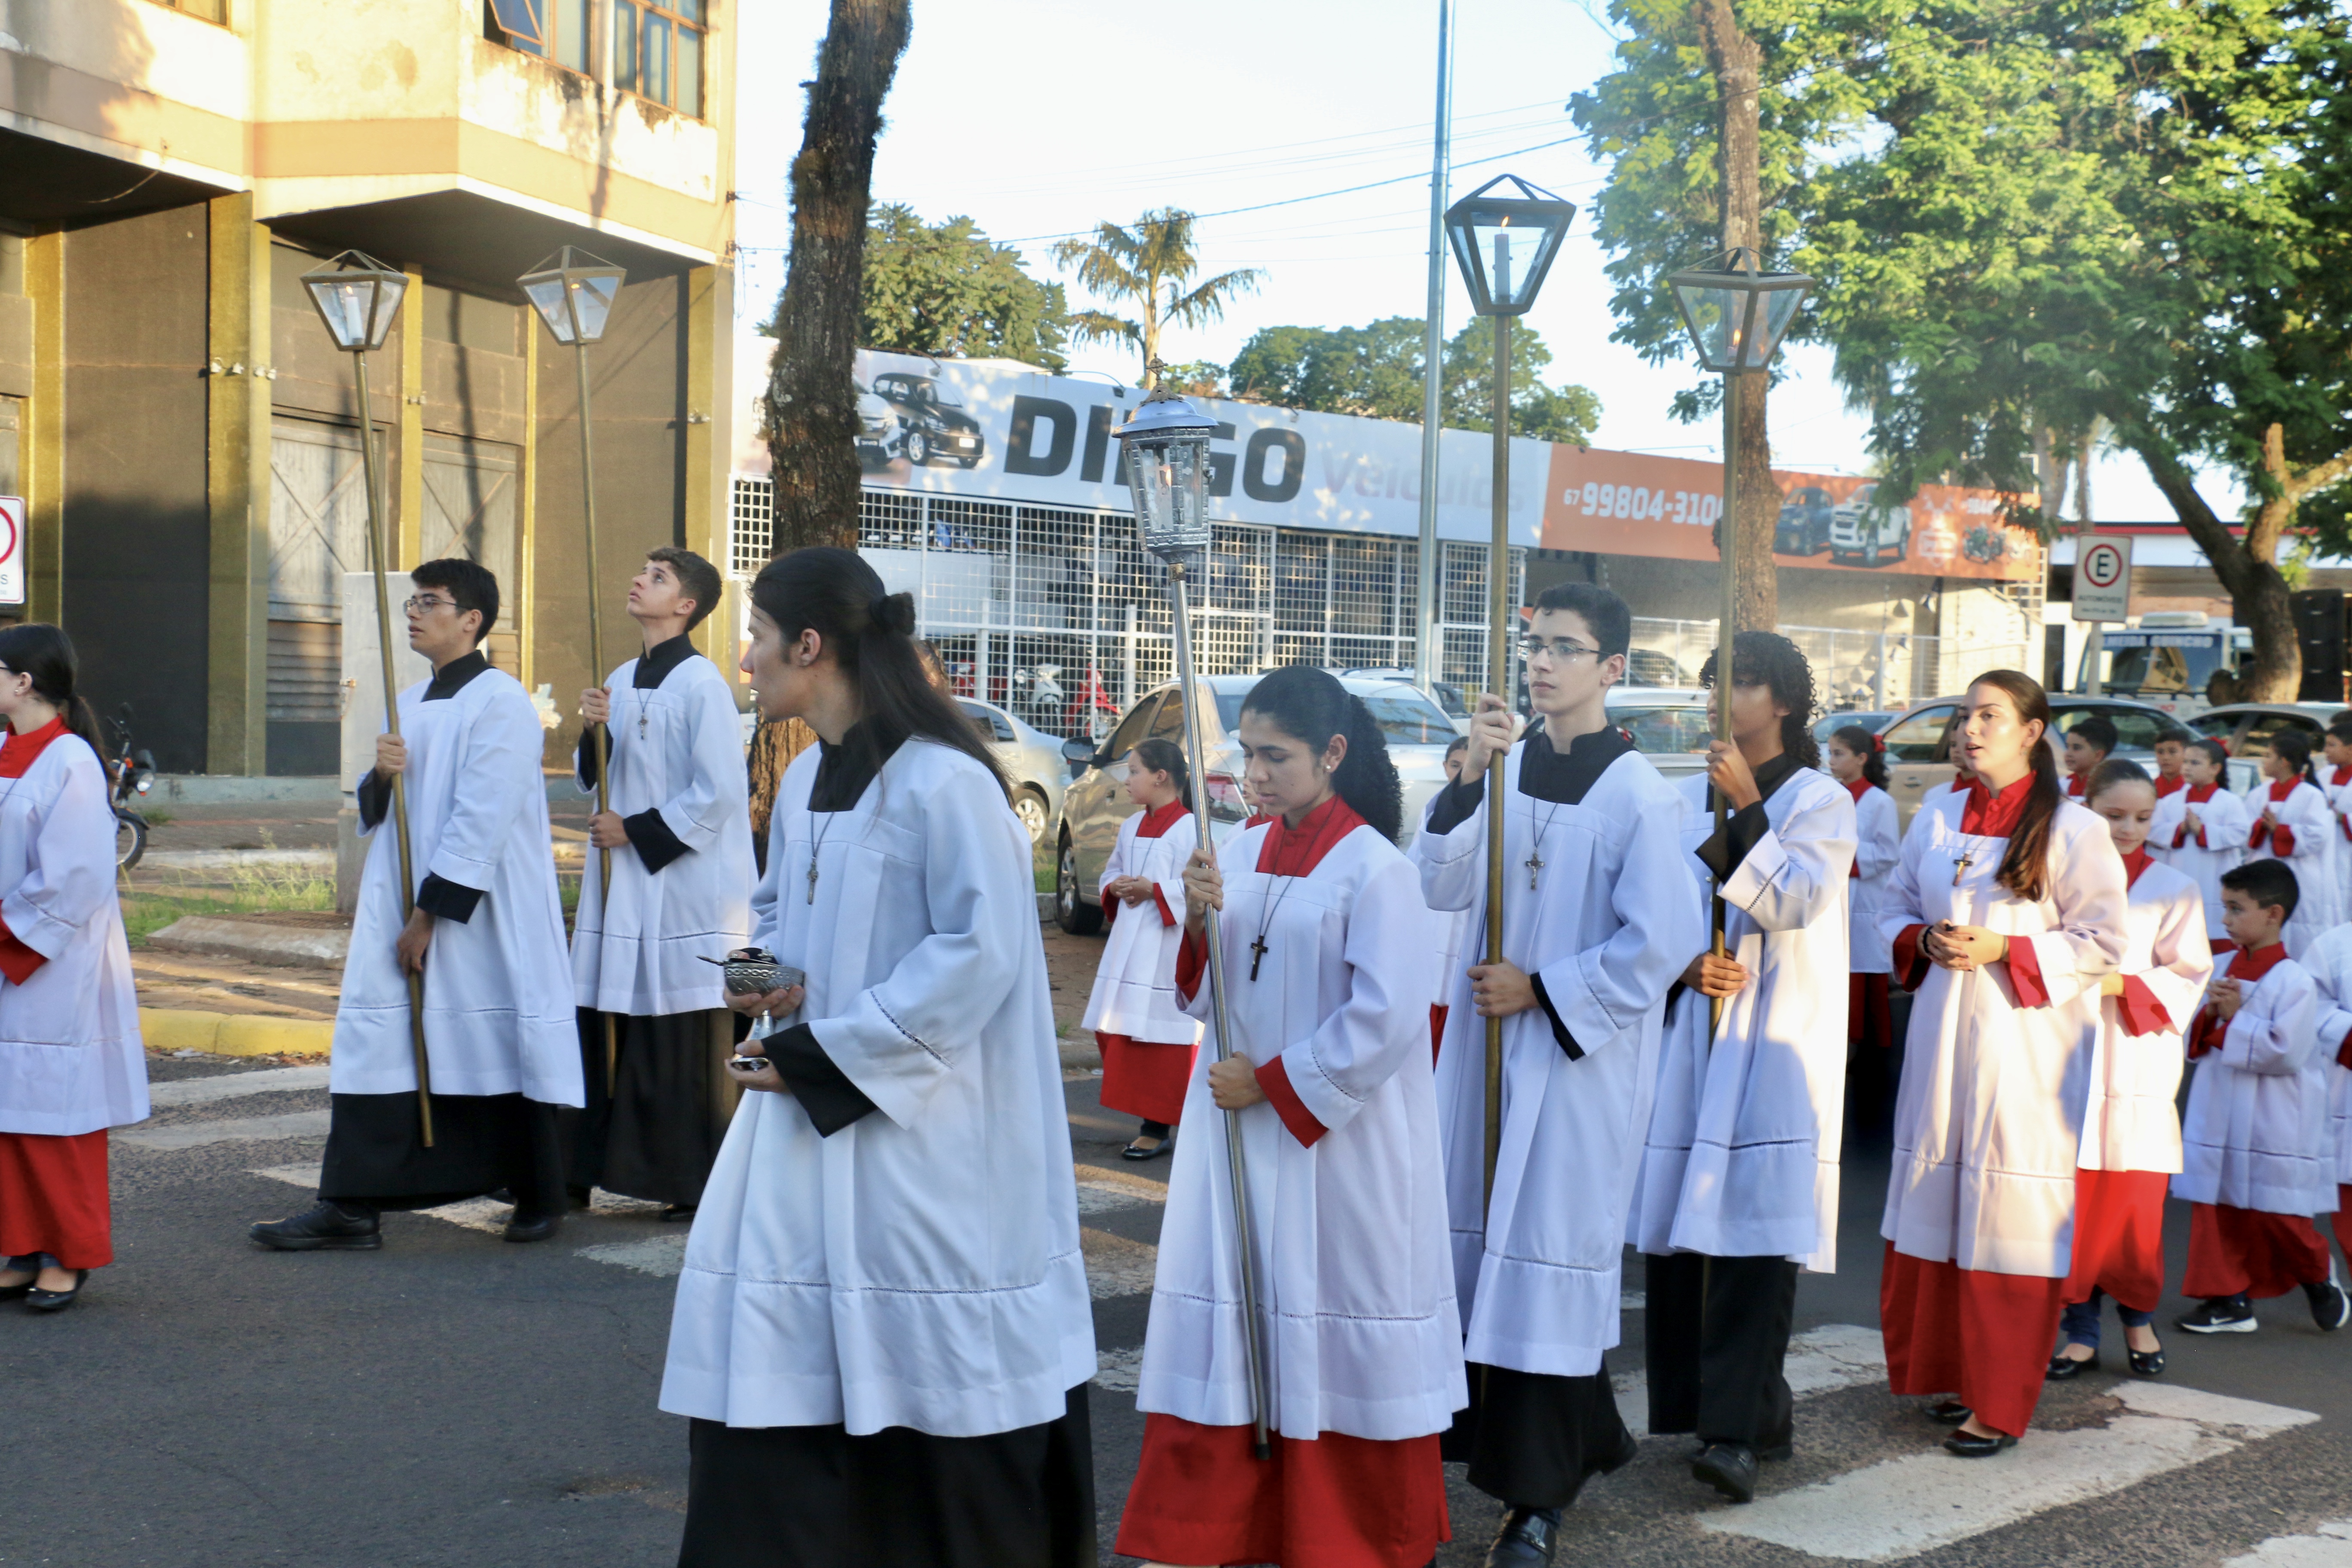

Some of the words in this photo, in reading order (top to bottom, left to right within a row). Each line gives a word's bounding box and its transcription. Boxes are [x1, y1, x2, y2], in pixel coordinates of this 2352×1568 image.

[1004, 394, 1306, 503] DIGO
[1563, 488, 1580, 505] 67
[1581, 481, 1724, 527] 99804-310
[2095, 552, 2111, 577] E
